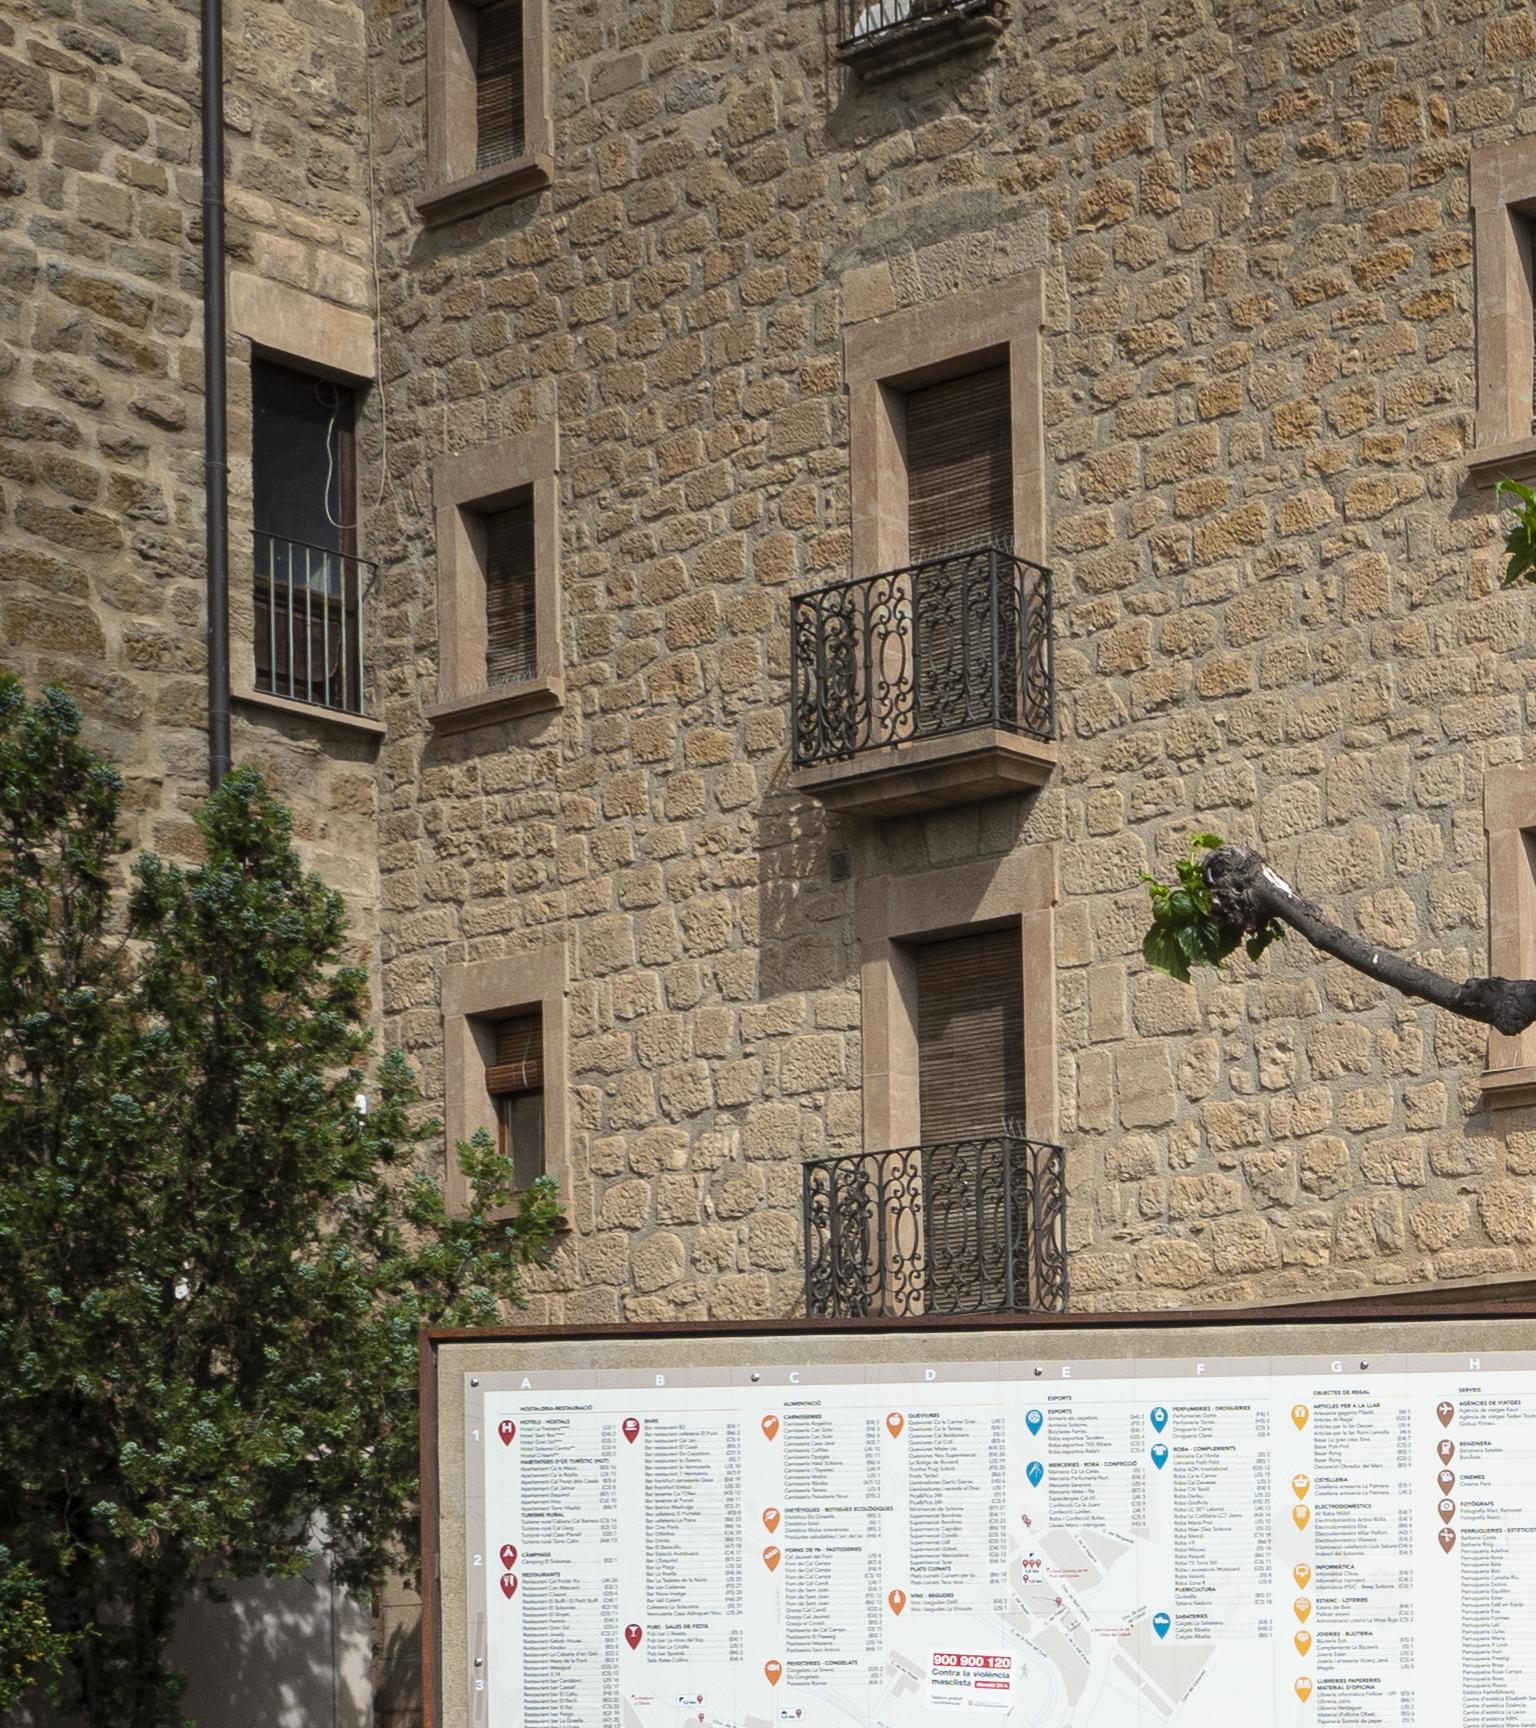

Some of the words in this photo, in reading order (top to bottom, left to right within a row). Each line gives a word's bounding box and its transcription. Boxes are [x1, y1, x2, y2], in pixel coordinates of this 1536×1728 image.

[520, 1377, 532, 1389] A
[655, 1374, 666, 1386] B
[789, 1371, 800, 1383] C
[925, 1368, 937, 1381] D
[1062, 1366, 1071, 1379] E
[1196, 1363, 1205, 1376] F
[1331, 1360, 1343, 1373] G
[1468, 1358, 1481, 1371] H
[472, 1429, 480, 1441] 1
[473, 1554, 482, 1566] 2
[934, 1654, 958, 1666] 900
[960, 1655, 984, 1667] 900
[987, 1657, 1010, 1668] 120
[931, 1668, 960, 1677] Contra
[963, 1669, 970, 1677] la
[973, 1671, 1010, 1679] violència
[475, 1679, 484, 1691] 3
[931, 1679, 971, 1687] masclista
